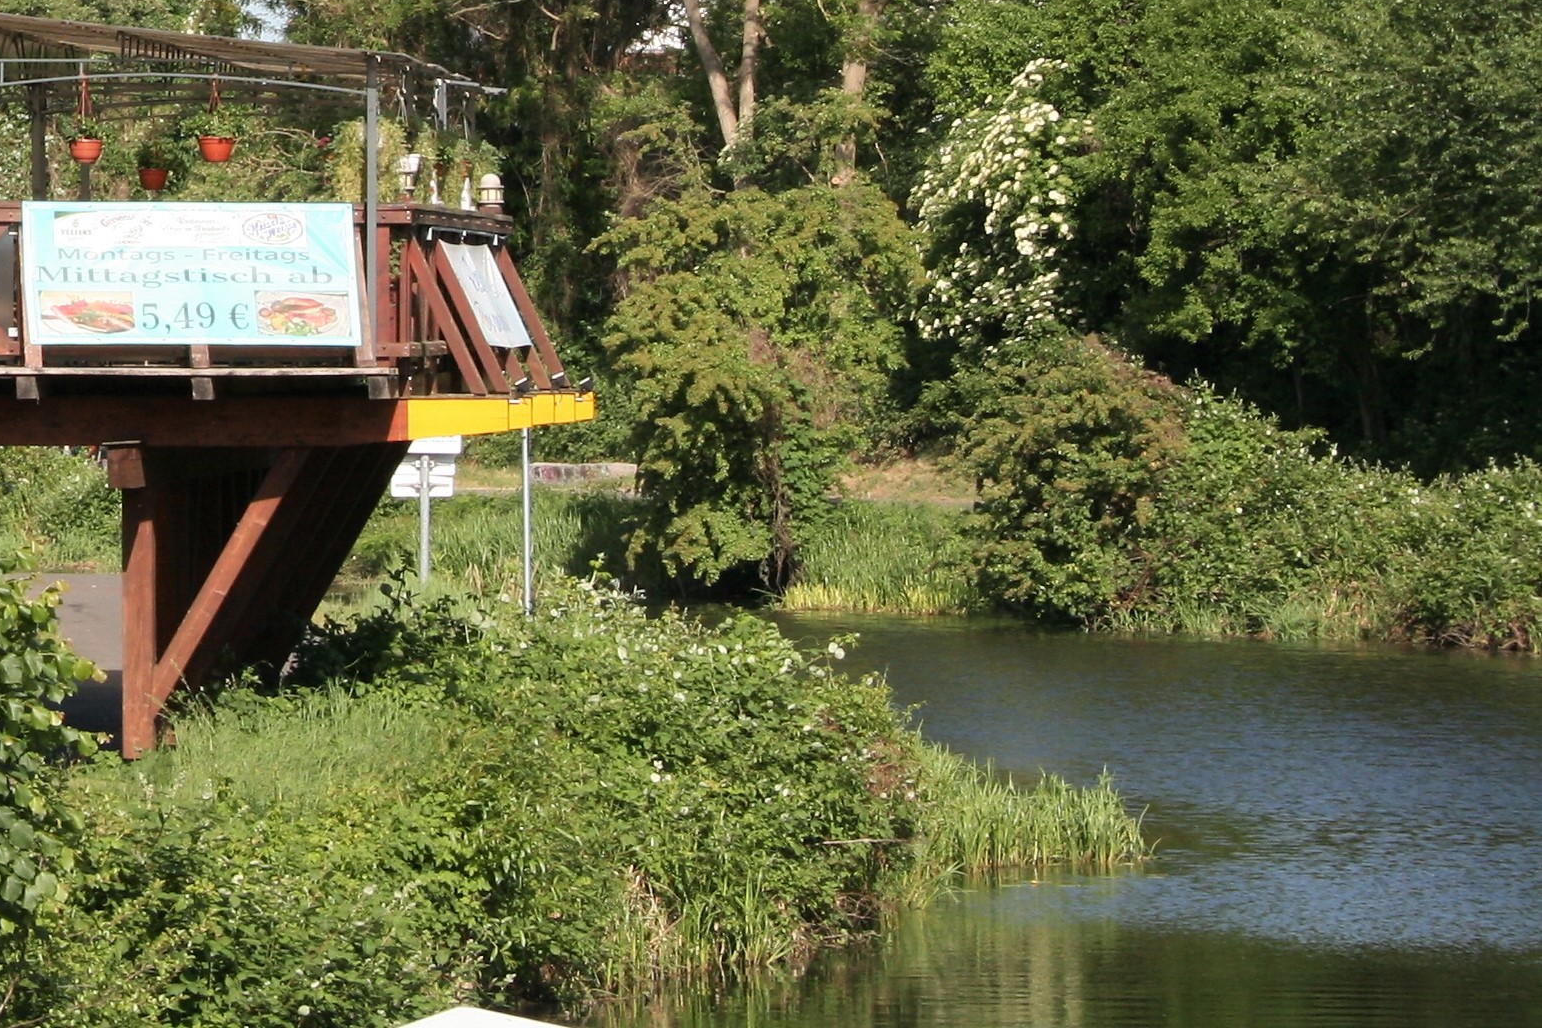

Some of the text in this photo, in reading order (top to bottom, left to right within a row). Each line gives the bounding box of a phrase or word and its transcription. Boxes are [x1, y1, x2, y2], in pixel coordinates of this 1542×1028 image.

[58, 248, 175, 264] Montags
[202, 248, 310, 264] Freitags
[36, 265, 333, 288] Mittagstisch ab
[141, 301, 249, 334] 5,49 €
